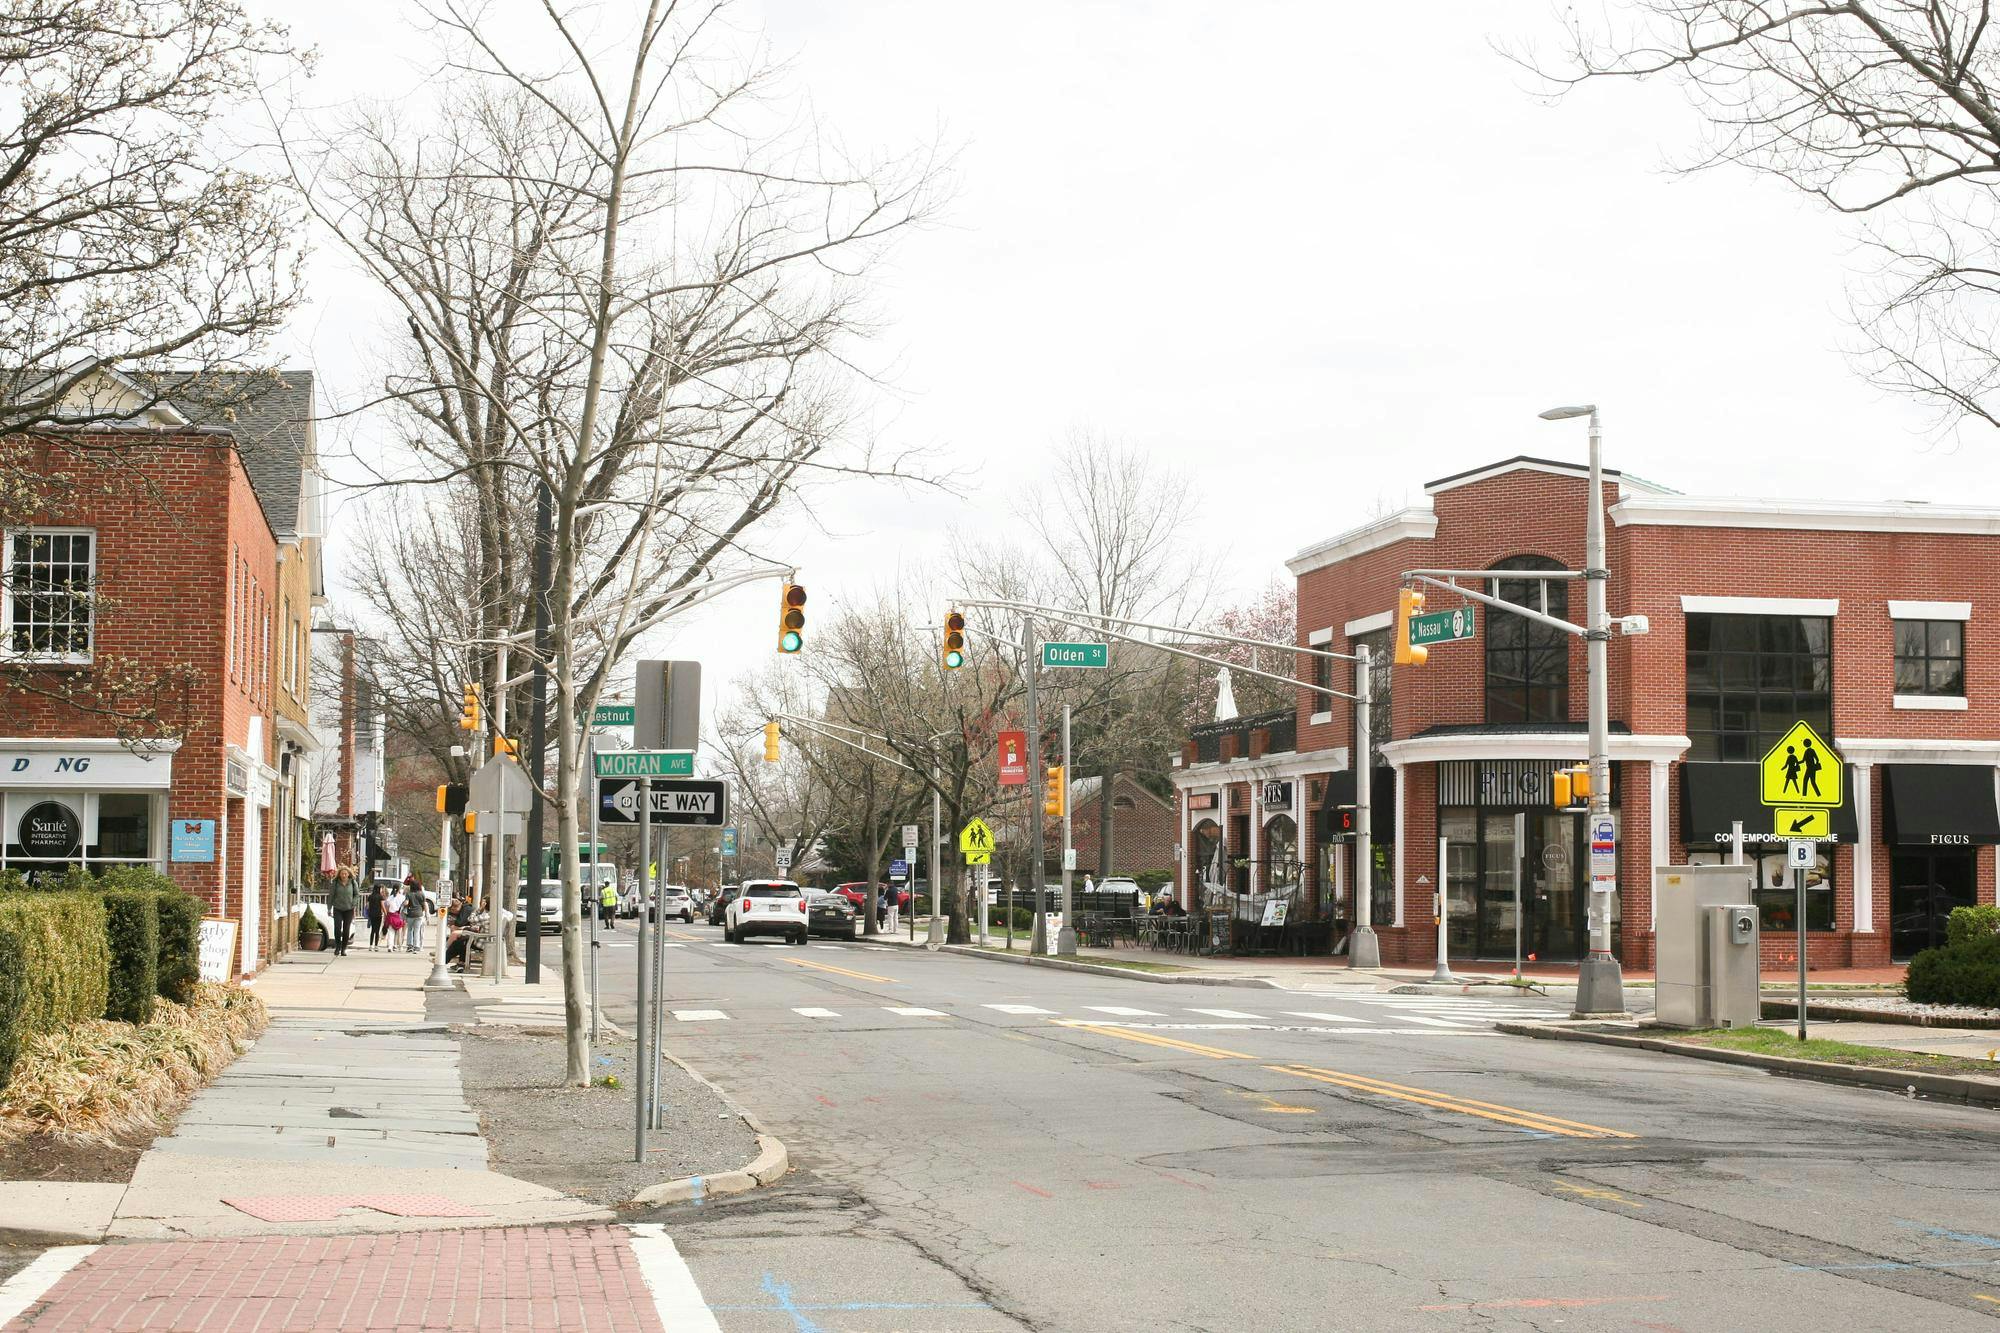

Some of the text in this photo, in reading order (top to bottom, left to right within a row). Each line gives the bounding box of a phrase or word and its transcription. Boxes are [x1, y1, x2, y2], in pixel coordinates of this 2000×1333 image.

[1418, 622, 1441, 637] Nassau
[1443, 618, 1449, 629] St
[1454, 616, 1462, 632] 27
[1050, 648, 1101, 661] Olden St
[582, 711, 630, 721] Cestnut
[54, 758, 90, 773] NG
[600, 756, 687, 774] MORAN AVE
[1481, 771, 1554, 795] FIC
[676, 794, 710, 811] WAY
[31, 817, 67, 833] Santé
[1343, 813, 1350, 828] 6
[1930, 834, 1970, 844] FICUS
[777, 857, 790, 865] 25
[1798, 848, 1806, 860] B
